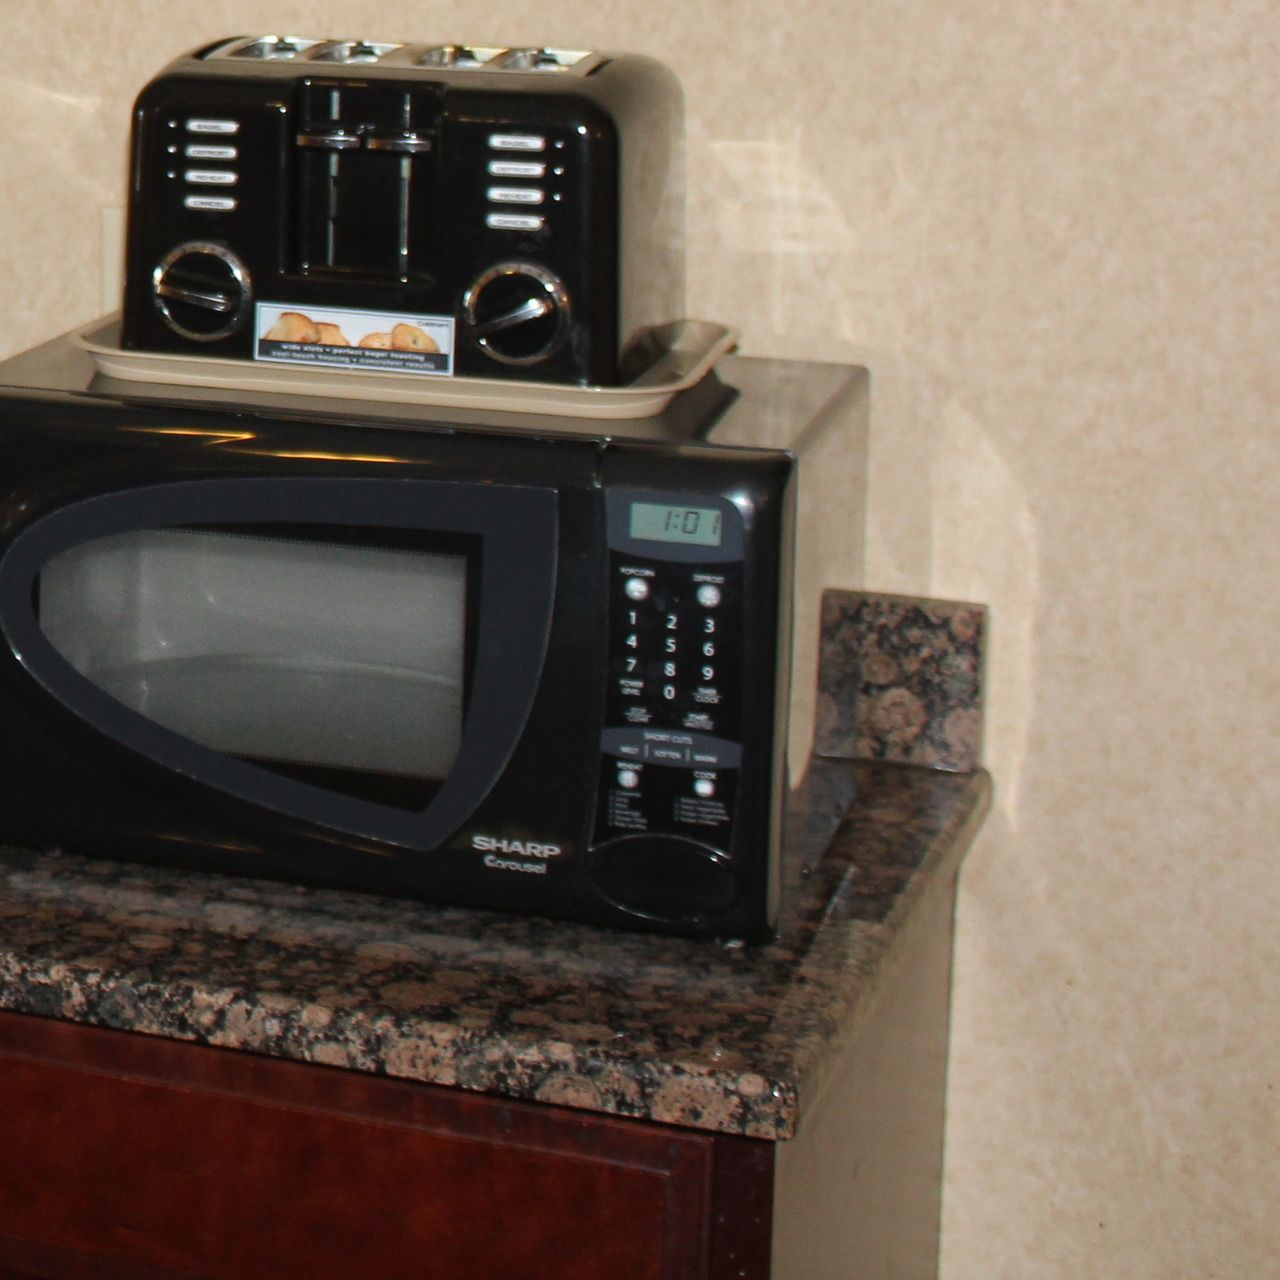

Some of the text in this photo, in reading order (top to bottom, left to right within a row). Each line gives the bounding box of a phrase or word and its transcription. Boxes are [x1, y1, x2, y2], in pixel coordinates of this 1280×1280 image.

[628, 611, 637, 625] 1
[666, 615, 678, 630] 2
[703, 619, 715, 633] 3
[626, 634, 638, 649] 4
[665, 638, 676, 653] 5
[702, 642, 715, 657] 6
[626, 658, 637, 673] 7
[664, 662, 676, 677] 8
[701, 666, 714, 680] 9
[663, 685, 676, 700] 0
[472, 835, 561, 858] SHARP
[483, 854, 547, 874] Carousel
